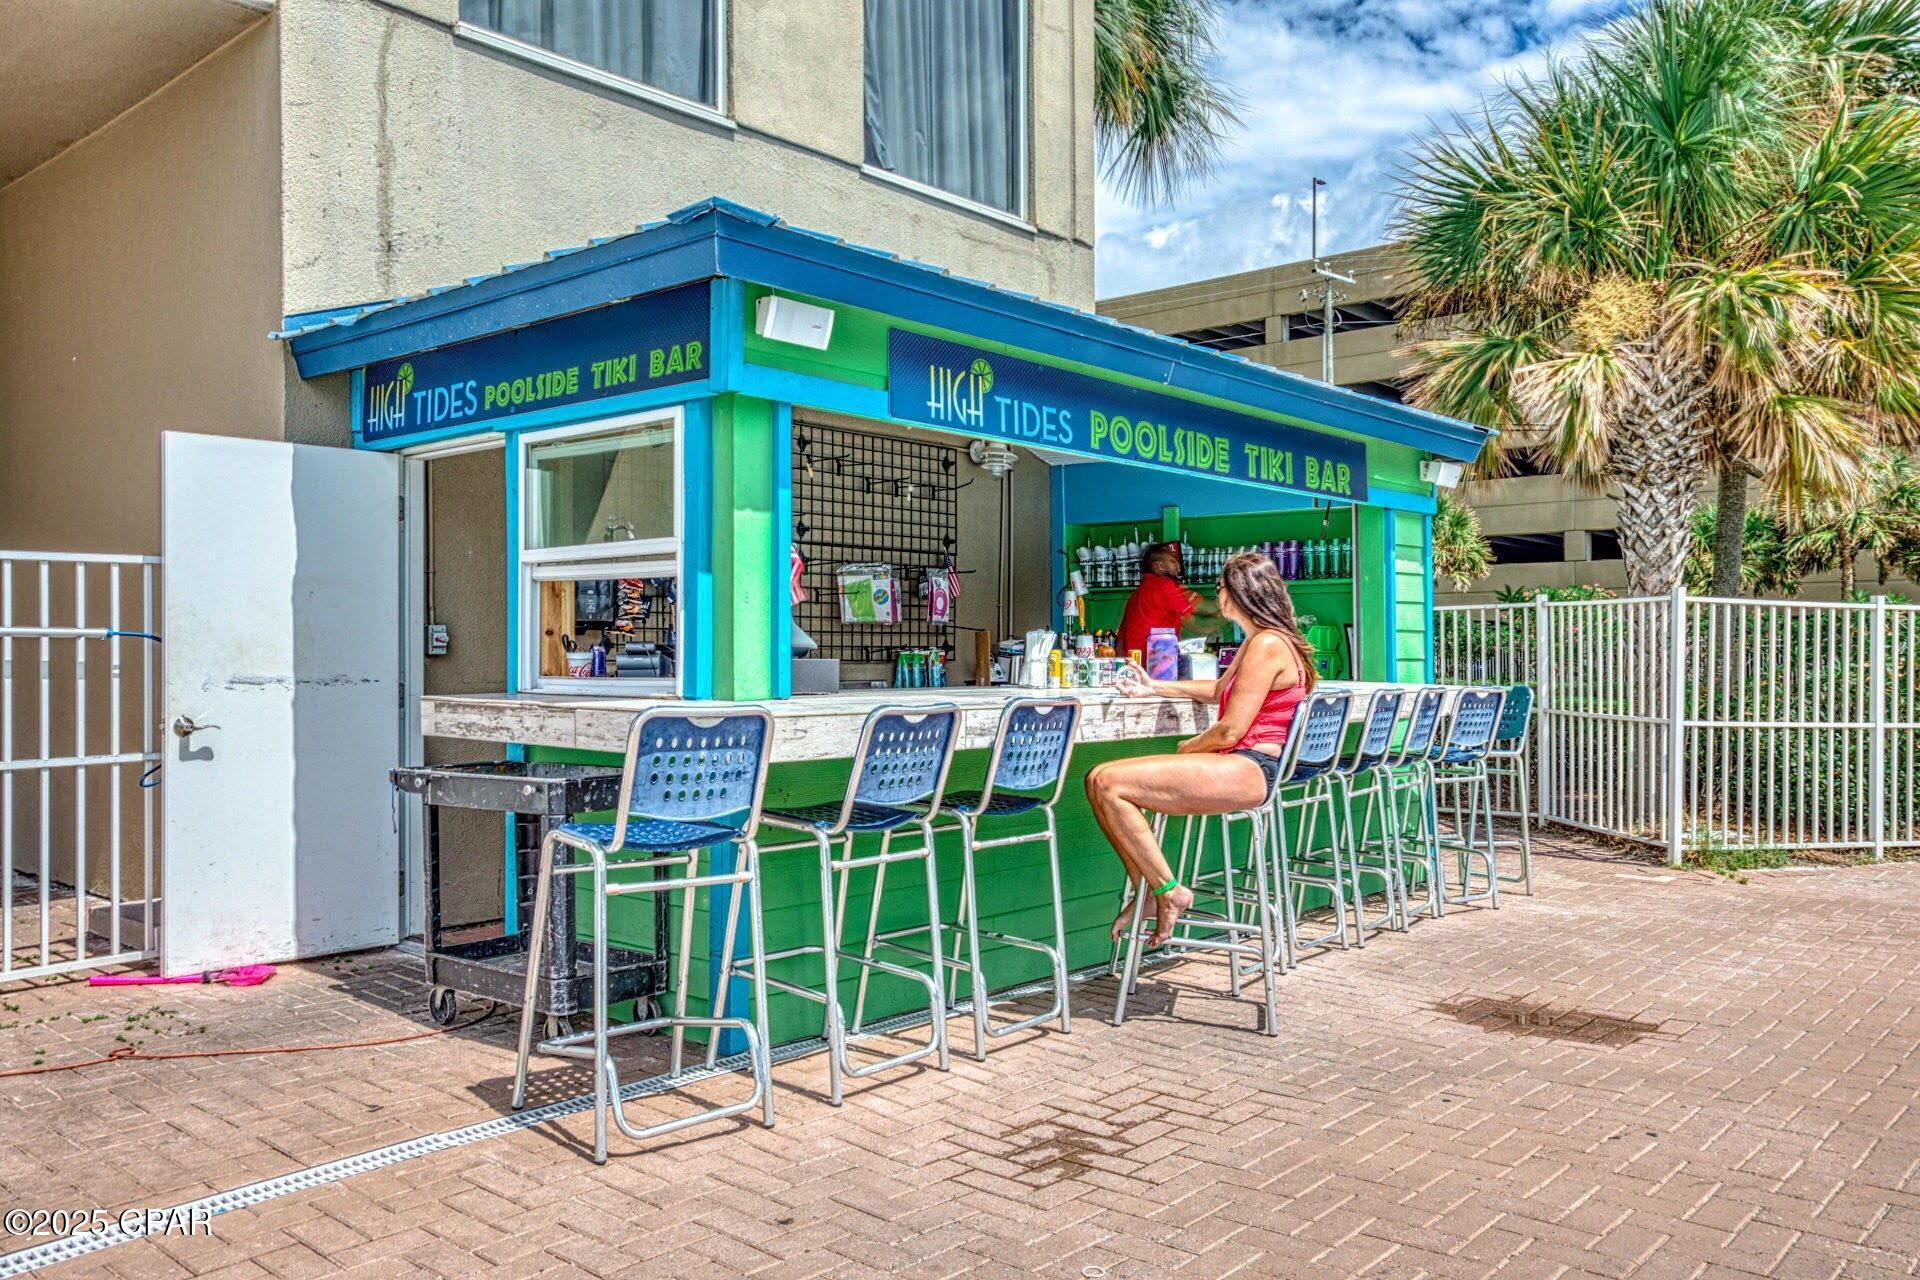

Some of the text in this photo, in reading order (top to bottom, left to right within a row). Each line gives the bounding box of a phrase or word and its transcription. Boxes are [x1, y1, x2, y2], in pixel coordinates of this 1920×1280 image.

[367, 340, 703, 432] HIGH TIDES POOLSIDE TIKI BAR
[926, 364, 1352, 496] HIGH TIDES POOLSIDE TIKI BAR
